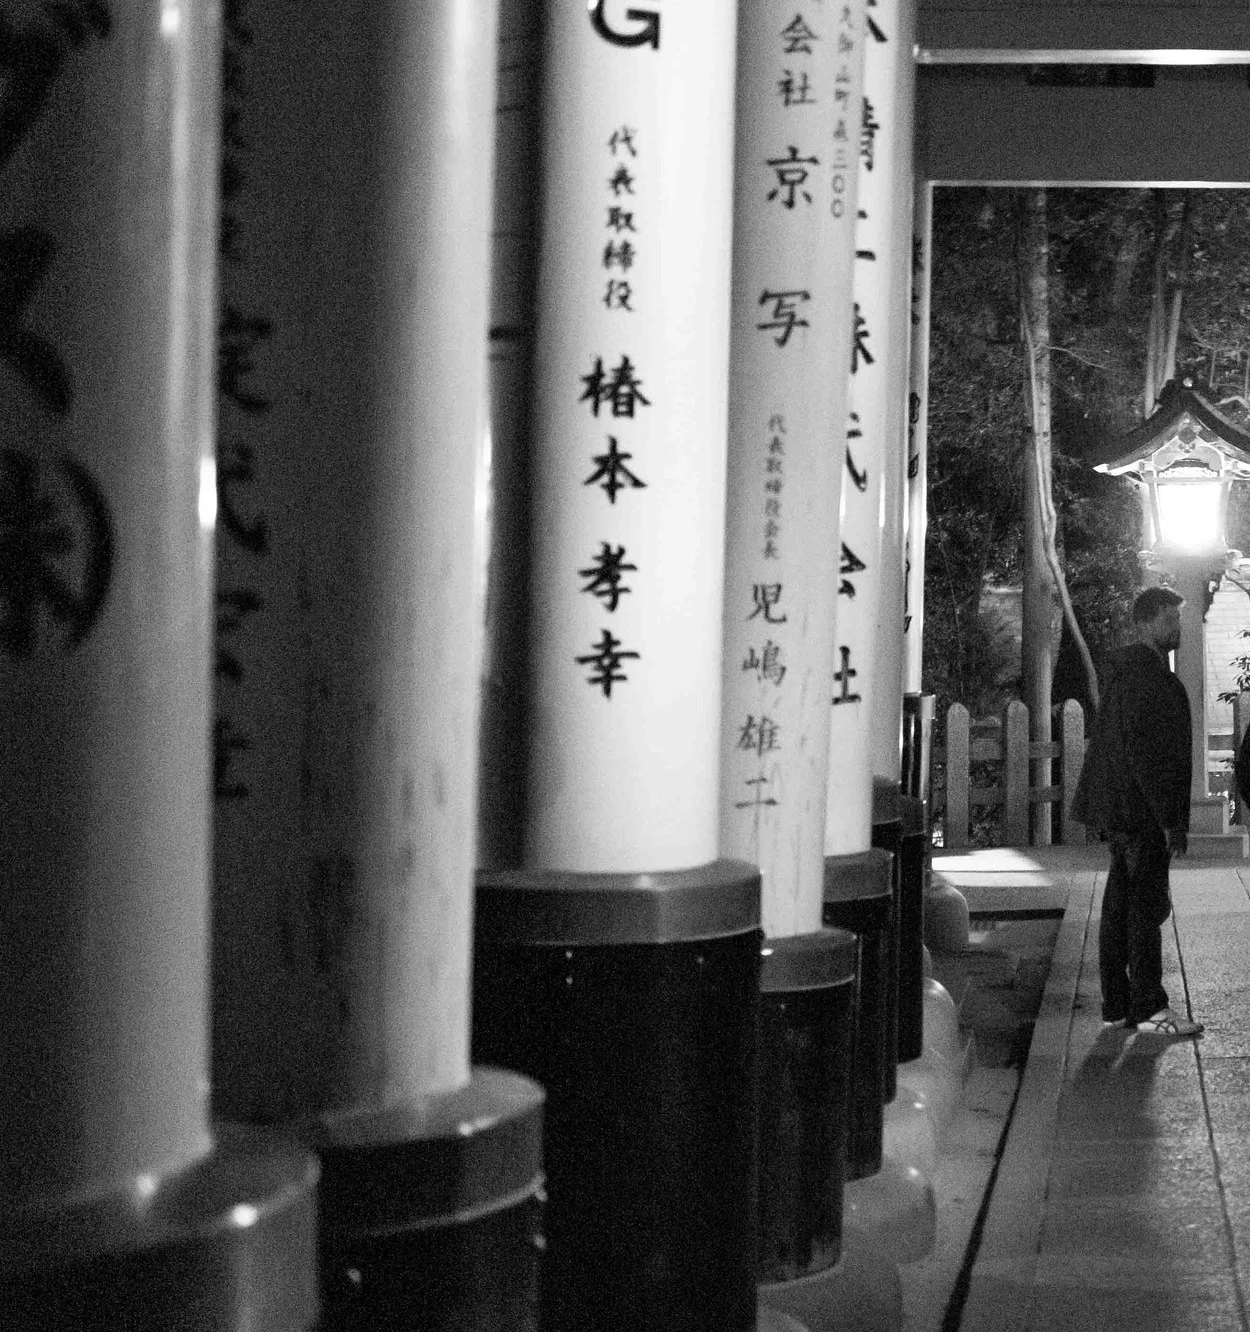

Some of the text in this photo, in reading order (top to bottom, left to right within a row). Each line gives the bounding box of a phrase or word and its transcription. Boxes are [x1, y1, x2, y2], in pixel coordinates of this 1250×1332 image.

[575, 125, 651, 699] 代表取締役 椿本孝幸
